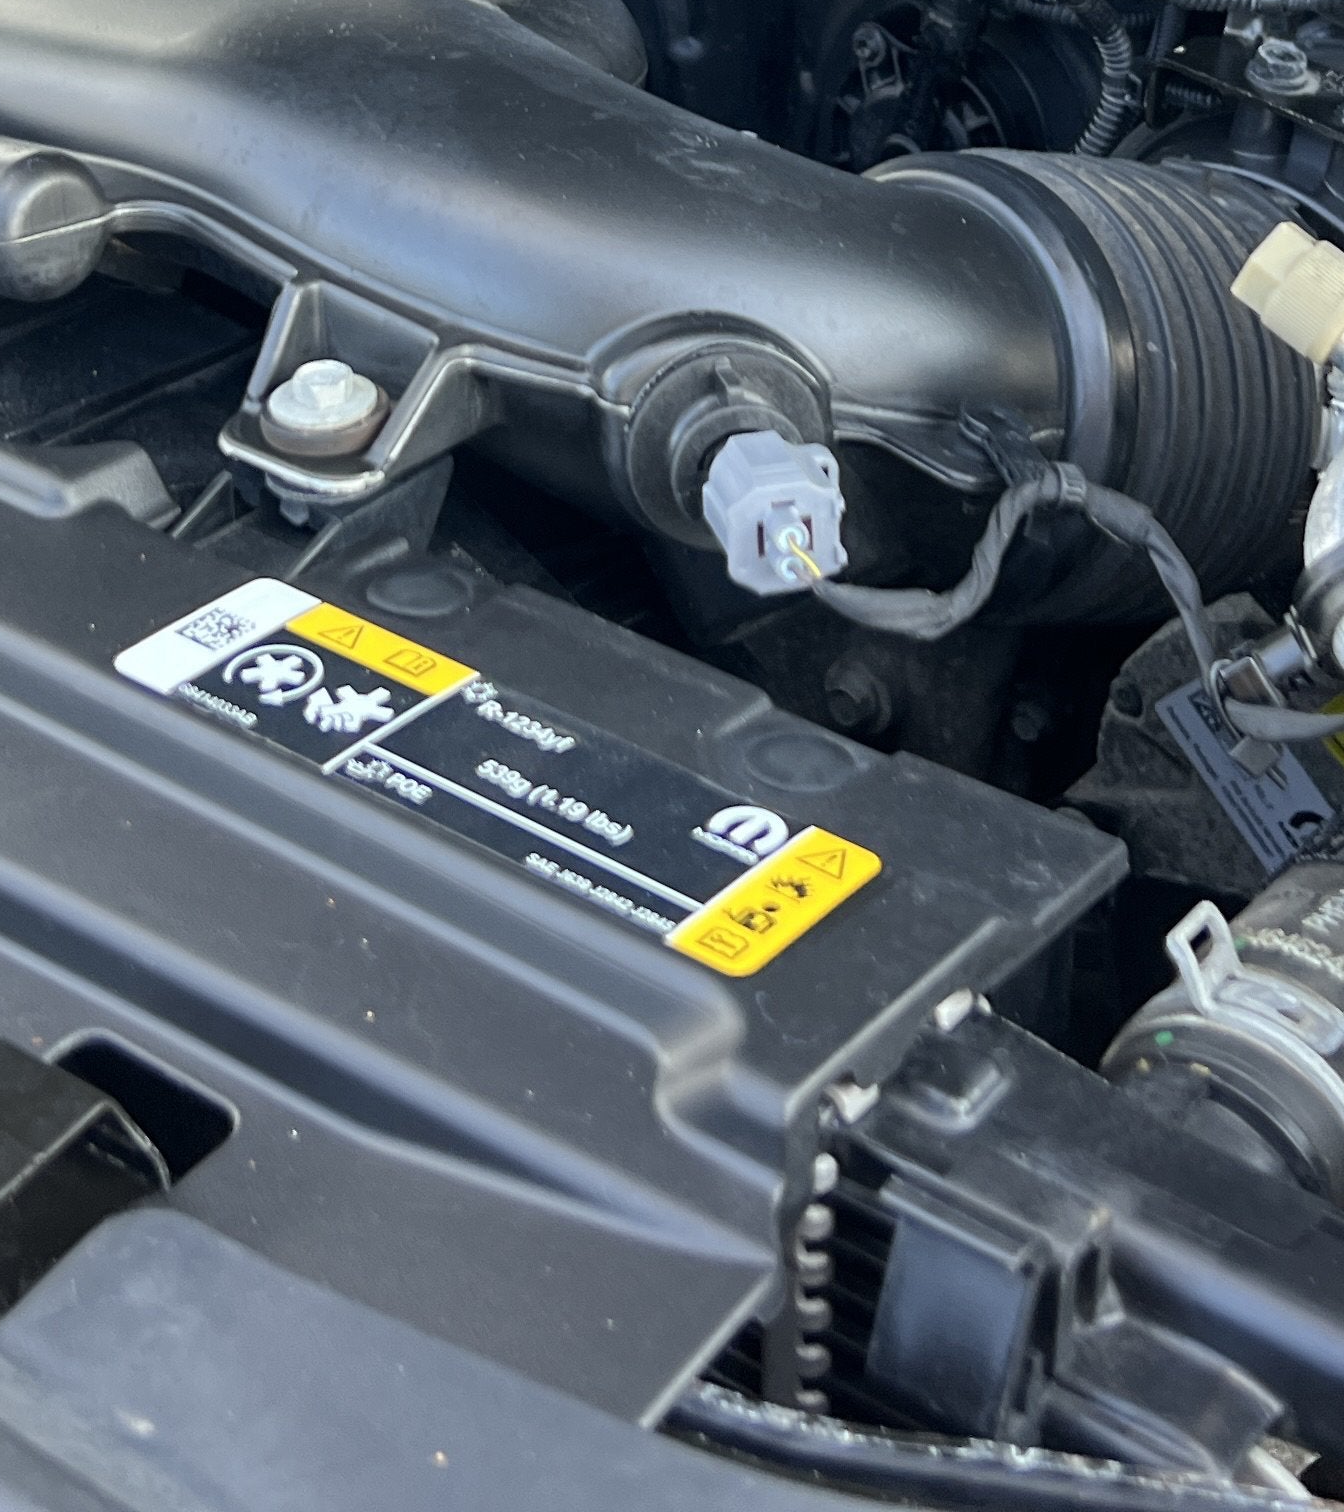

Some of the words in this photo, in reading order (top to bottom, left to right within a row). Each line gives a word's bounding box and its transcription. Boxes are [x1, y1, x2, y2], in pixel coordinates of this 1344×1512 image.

[476, 700, 576, 753] R-1234yf
[384, 773, 433, 806] POE
[475, 759, 533, 799] 539g
[526, 784, 590, 823] (1.19
[583, 809, 635, 847] lbs)
[525, 853, 560, 879] SAE
